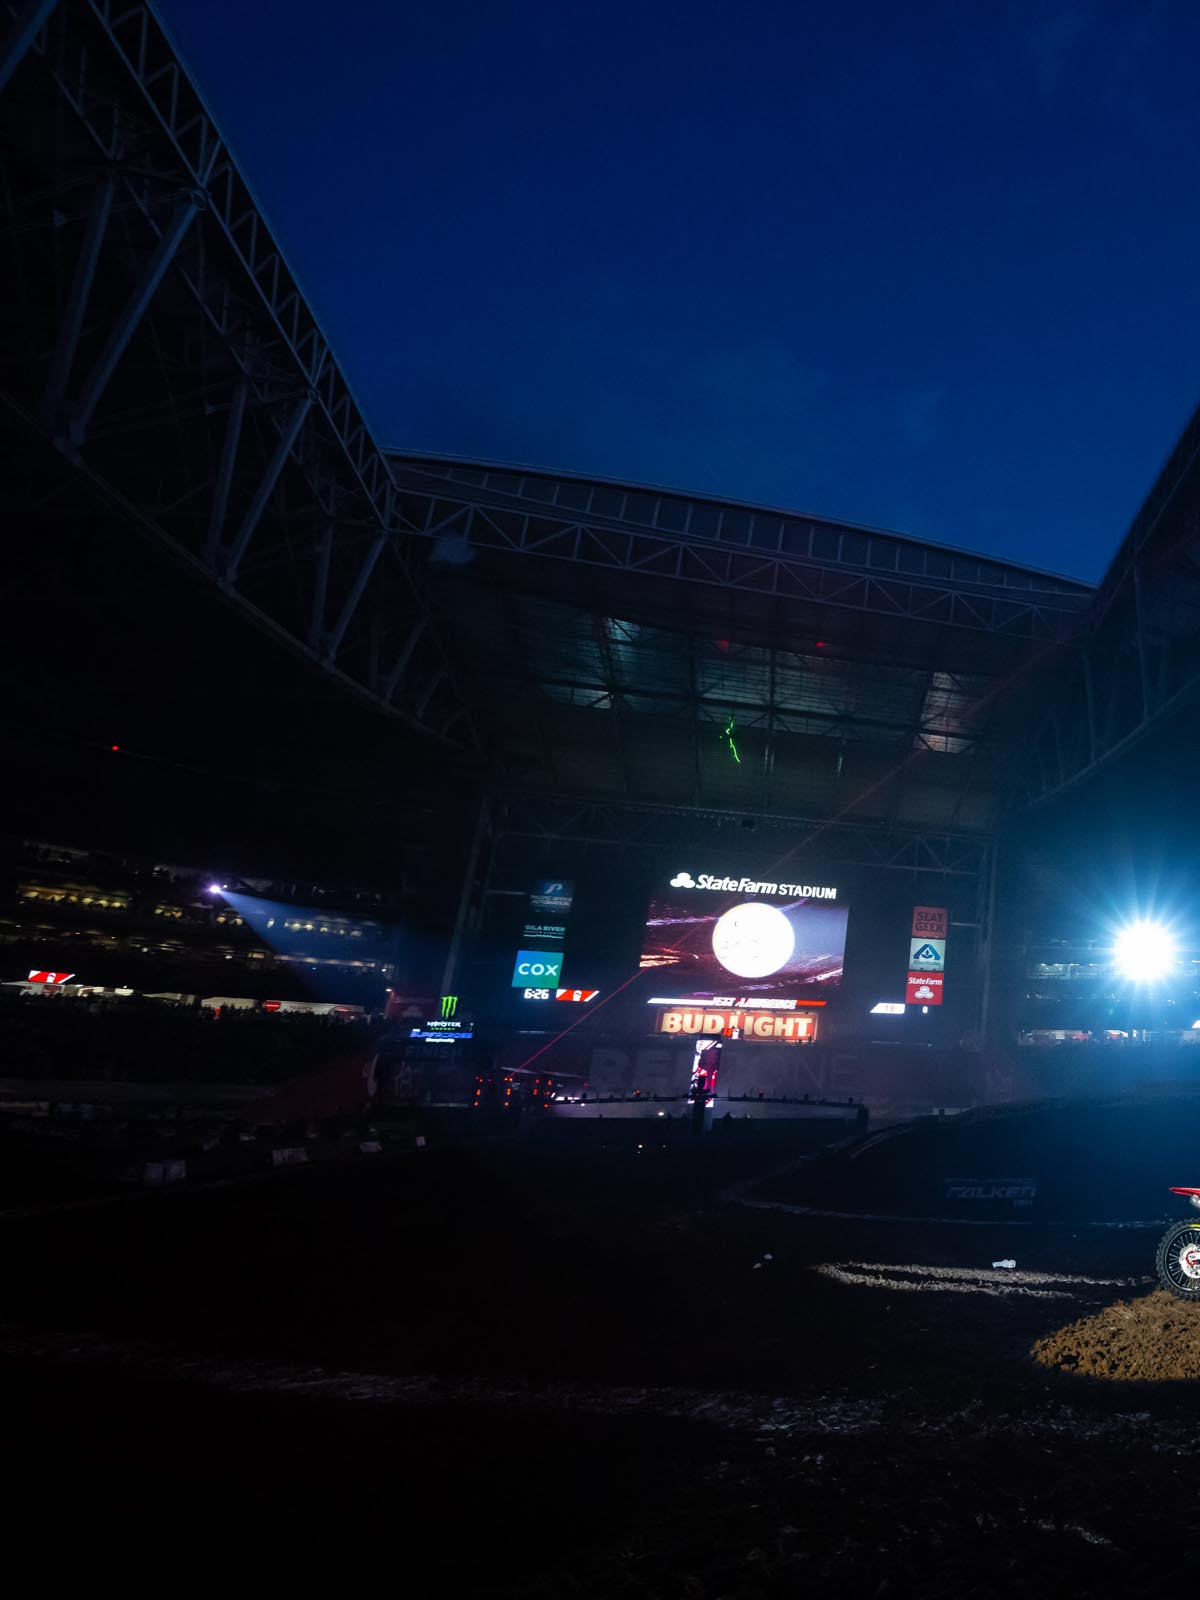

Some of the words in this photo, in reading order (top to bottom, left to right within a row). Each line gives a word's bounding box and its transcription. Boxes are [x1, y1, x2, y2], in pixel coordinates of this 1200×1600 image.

[778, 884, 837, 899] STADIUM
[917, 911, 944, 923] SEAT
[915, 922, 944, 934] GEEK
[518, 963, 559, 976] COX
[524, 988, 550, 999] 6:26
[661, 1013, 725, 1034] BUD
